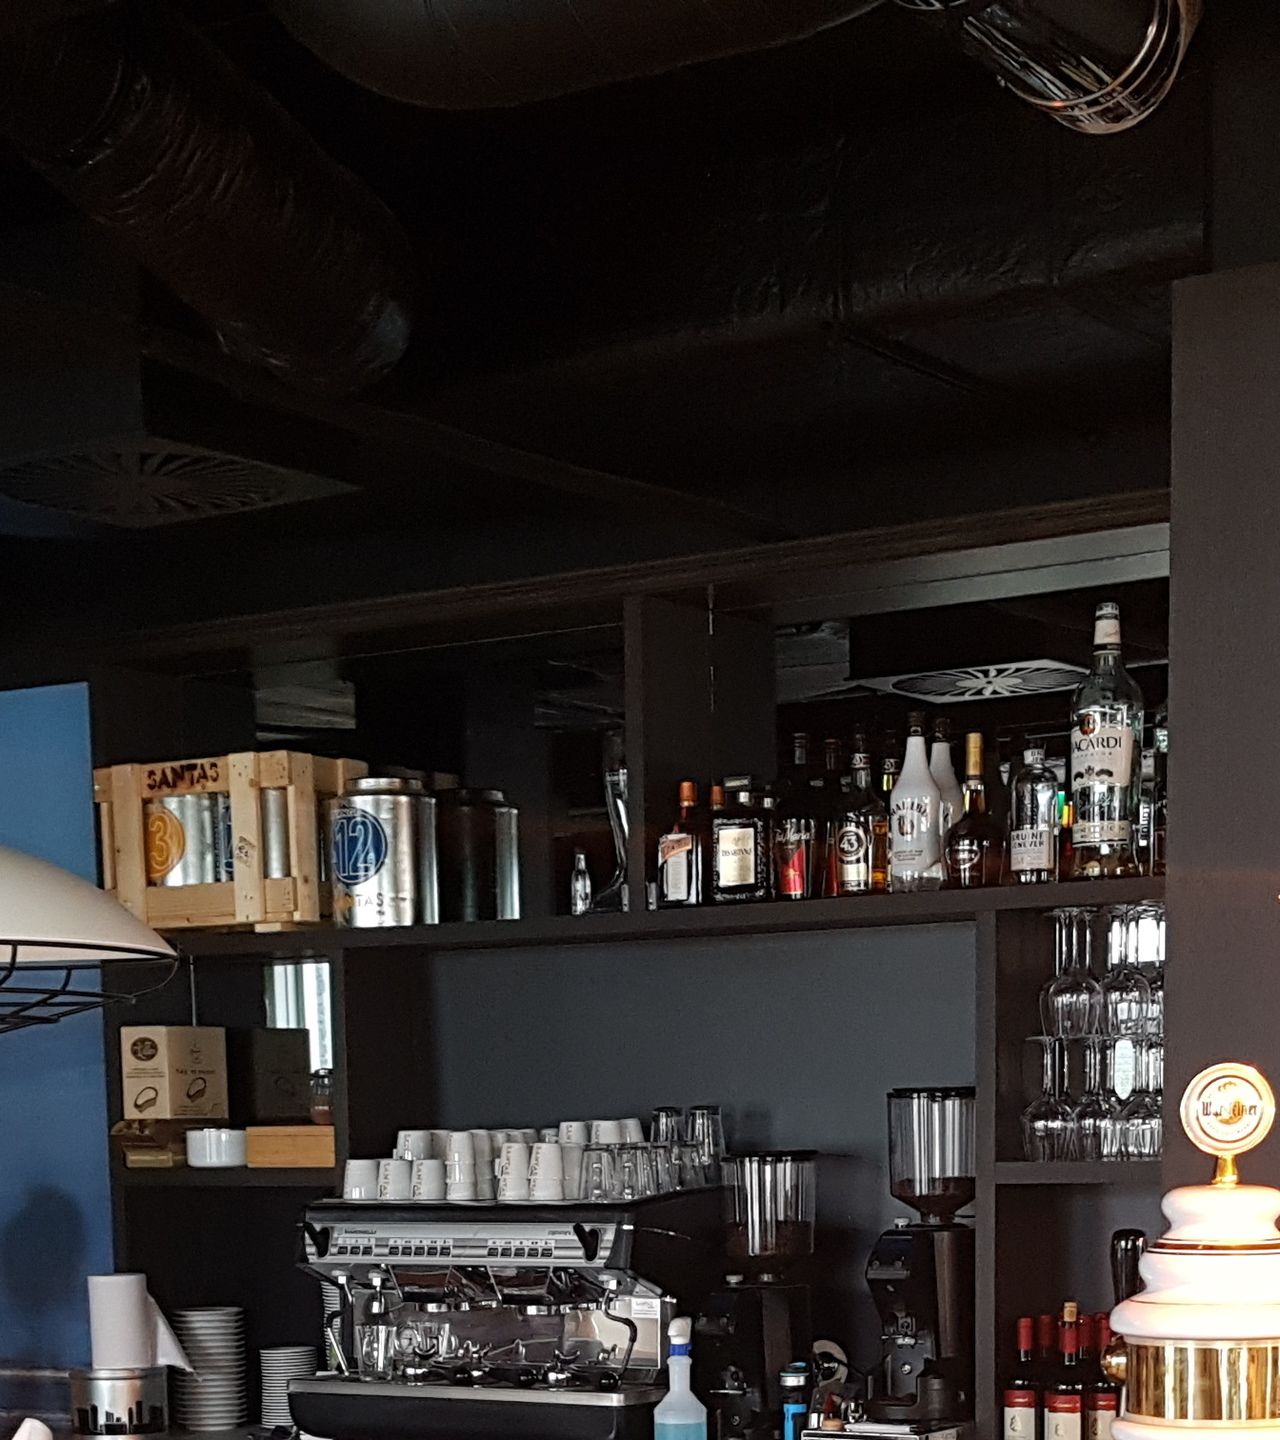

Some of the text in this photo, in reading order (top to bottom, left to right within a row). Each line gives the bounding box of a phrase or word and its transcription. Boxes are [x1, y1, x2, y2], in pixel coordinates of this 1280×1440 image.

[1073, 736, 1122, 753] ACARDI
[147, 763, 219, 791] SANTAS
[839, 835, 859, 851] 43
